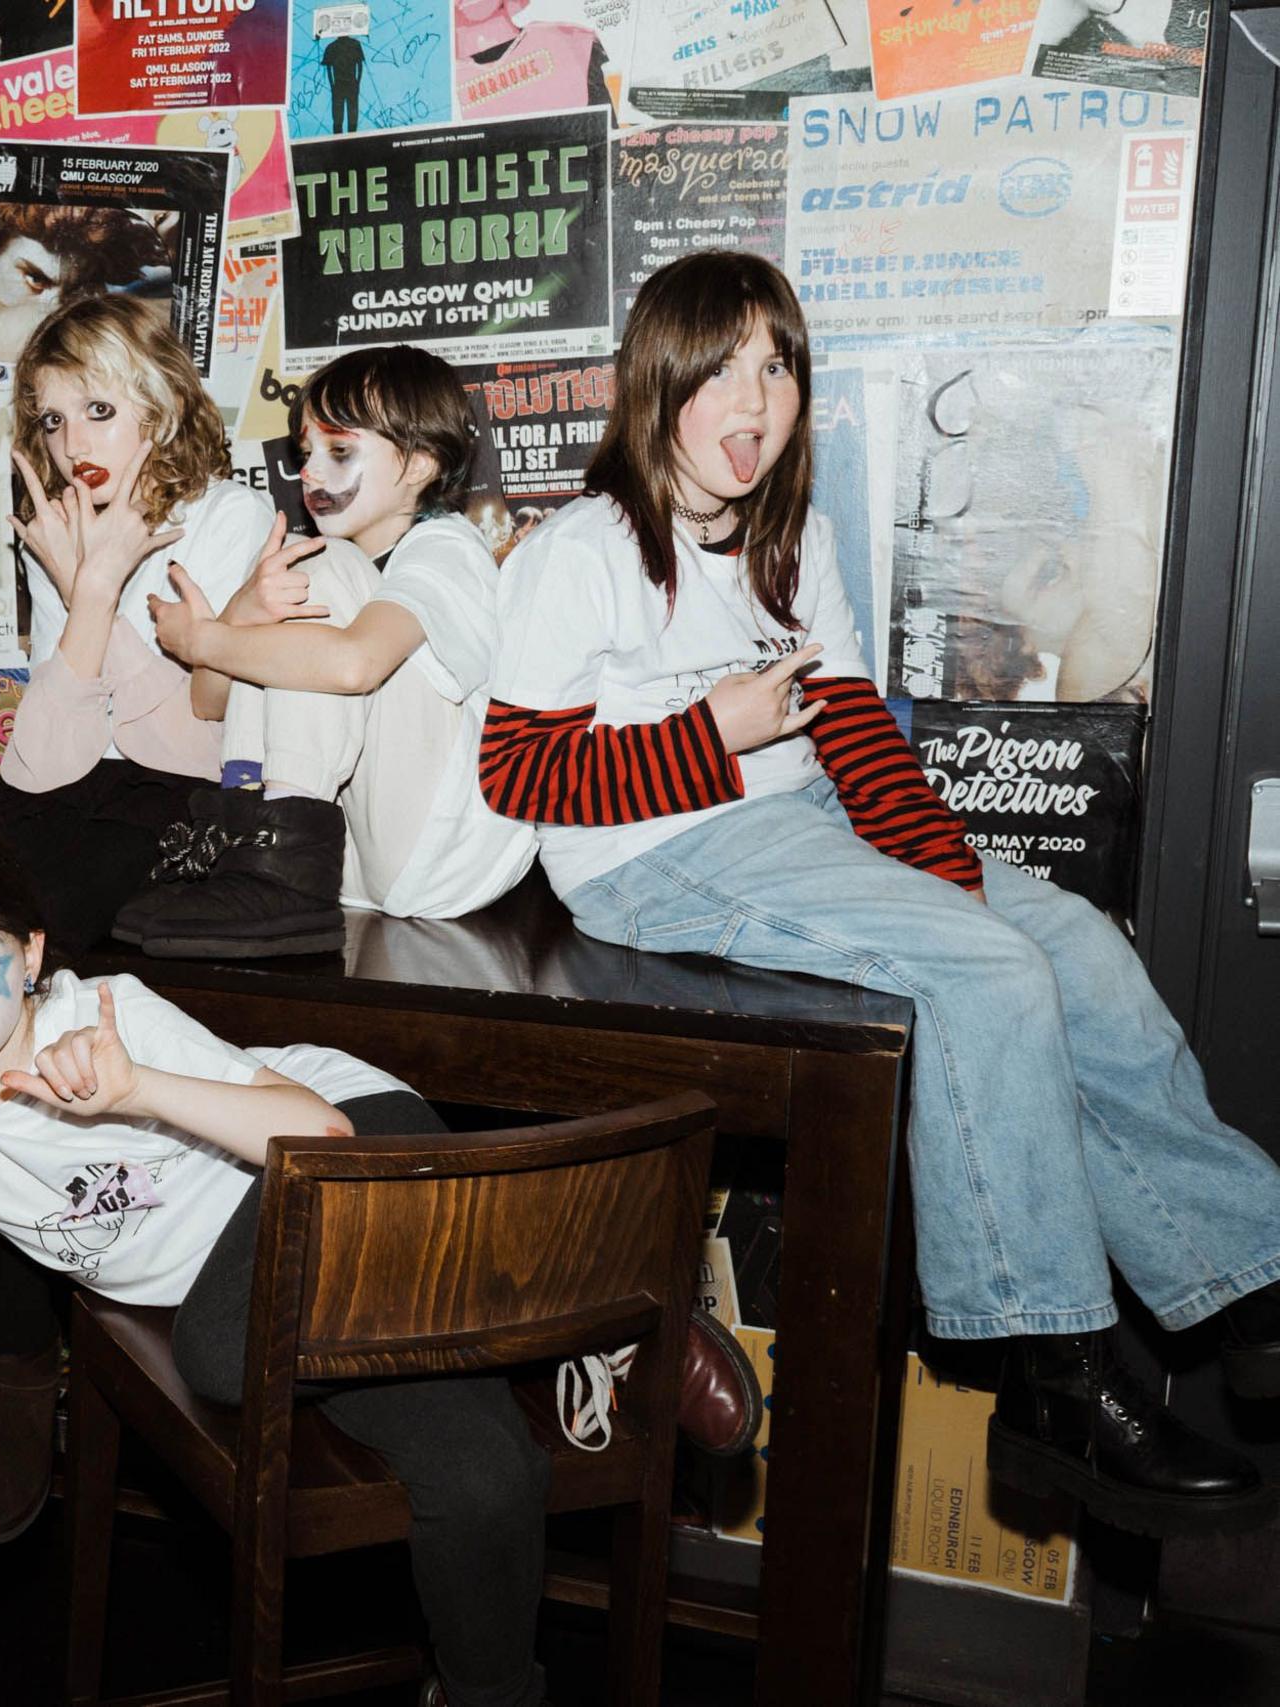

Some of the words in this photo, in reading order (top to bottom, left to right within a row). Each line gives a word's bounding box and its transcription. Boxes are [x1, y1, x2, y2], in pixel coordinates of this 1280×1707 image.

[138, 35, 155, 45] FAT
[157, 32, 185, 45] SAMS,
[187, 30, 224, 43] DUNDEE
[879, 12, 971, 45] saturday
[132, 47, 148, 58] FRI
[149, 47, 157, 57] 11
[158, 44, 207, 57] FEBRUARY
[208, 42, 231, 54] 2022
[130, 77, 147, 88] SAT
[149, 76, 160, 87] 12
[161, 74, 209, 87] FEBRUARY
[210, 72, 232, 84] 2022
[146, 64, 169, 77] QMU,
[170, 61, 217, 74] GLASGOW
[802, 99, 942, 149] SNOW
[974, 90, 1185, 138] PATROL
[664, 127, 735, 146] cheesy
[740, 127, 778, 143] pop
[61, 158, 75, 169] 15
[77, 159, 133, 173] FEBRUARY
[135, 161, 159, 173] 2020
[60, 171, 86, 182] QMU
[87, 173, 143, 186] GLASGOW
[295, 166, 388, 218] THE
[415, 145, 589, 208] MUSIC
[801, 169, 972, 213] astrid
[1129, 202, 1178, 216] WATER
[205, 212, 218, 246] THE
[634, 219, 664, 233] 8pm
[676, 217, 726, 232] Cheesy
[728, 215, 756, 231] Pop
[318, 222, 405, 276] THE
[650, 235, 680, 250] 9pm
[692, 232, 739, 248] Ceilidh
[200, 250, 216, 309] MURDER
[352, 282, 467, 311] GLASGOW
[473, 278, 534, 305] QMU
[337, 308, 426, 333] SUNDAY
[435, 304, 489, 326] 16TH
[493, 299, 551, 325] JUNE
[509, 423, 545, 449] FOR
[548, 424, 563, 446] A
[500, 450, 522, 472] DJ
[524, 447, 559, 470] SET
[918, 738, 960, 767] The
[957, 720, 1084, 781] Pigeon
[922, 767, 1101, 817] Detectives
[963, 832, 988, 848] 09
[991, 834, 1036, 851] MAY
[1039, 836, 1087, 852] 2020
[932, 1478, 944, 1521] LIQUID
[944, 1487, 963, 1570] EDINBURGH
[972, 1535, 983, 1547] 11
[928, 1524, 940, 1567] ROOM
[1048, 1548, 1060, 1563] 05
[967, 1549, 981, 1574] FEB
[1002, 1548, 1016, 1581] QMU
[1043, 1565, 1057, 1590] FEB
